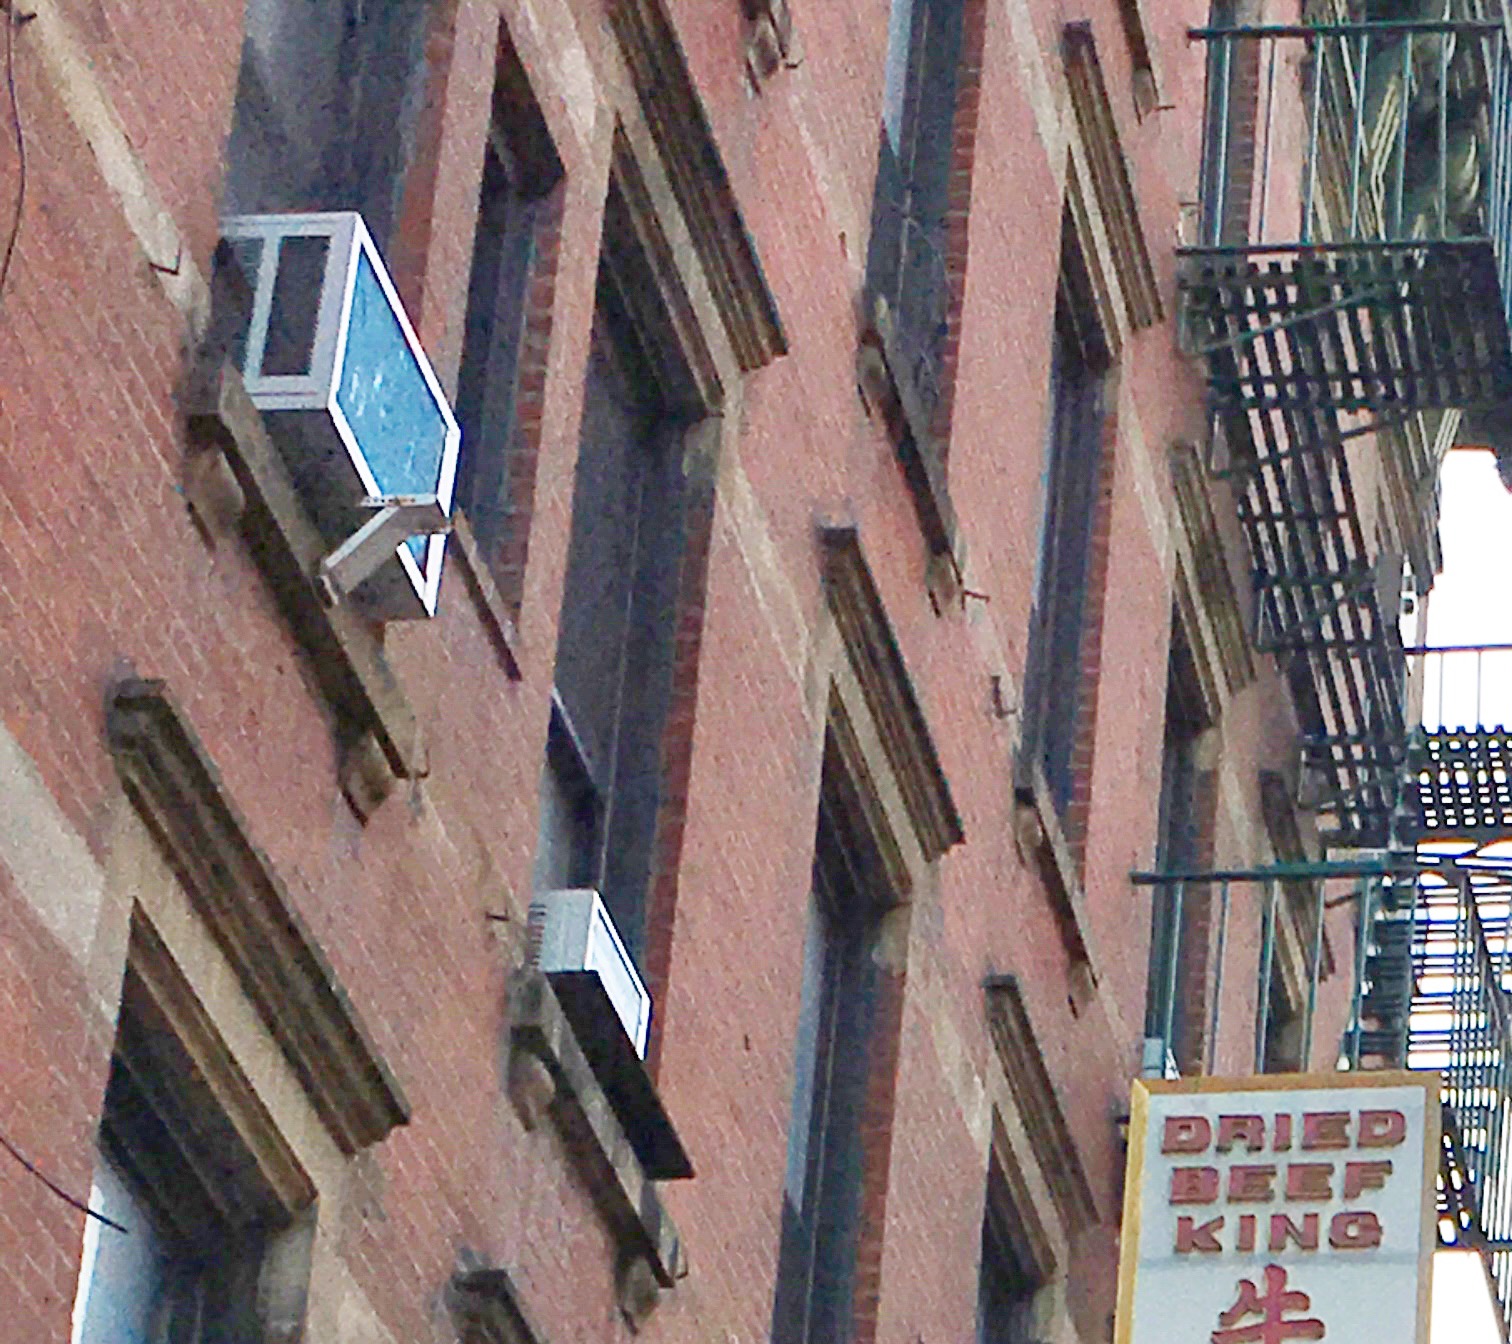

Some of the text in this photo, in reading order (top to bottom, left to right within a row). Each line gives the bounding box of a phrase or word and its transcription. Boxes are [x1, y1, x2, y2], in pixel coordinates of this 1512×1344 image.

[1161, 1110, 1407, 1155] DRIED
[1169, 1161, 1392, 1205] BEEF
[1175, 1211, 1383, 1253] KING
